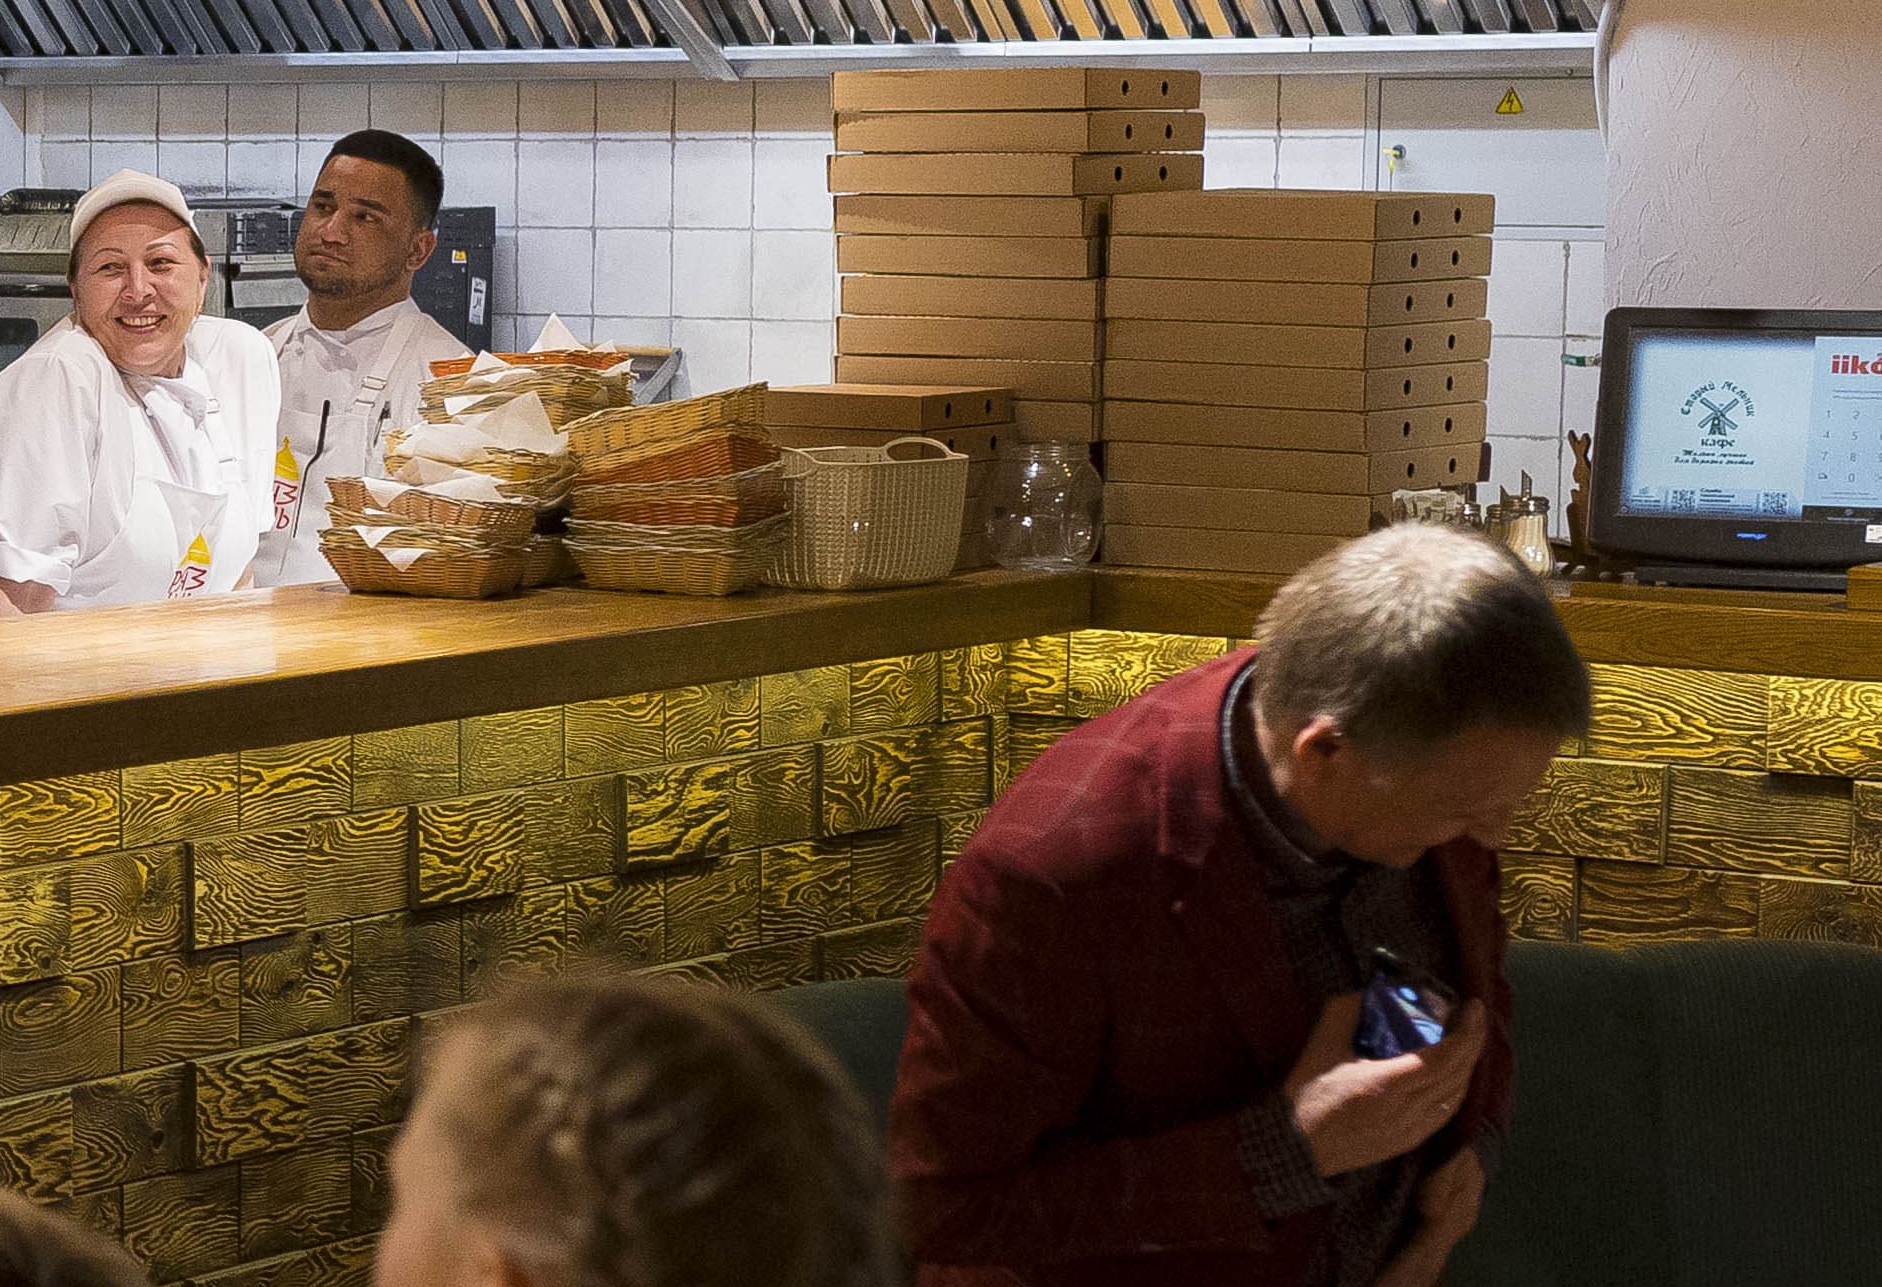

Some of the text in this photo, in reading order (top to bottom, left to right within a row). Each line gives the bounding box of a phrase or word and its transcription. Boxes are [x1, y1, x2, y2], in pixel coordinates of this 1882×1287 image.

[1680, 380, 1716, 416] Старый
[1721, 381, 1755, 417] Мельник
[1701, 438, 1736, 449] кафе
